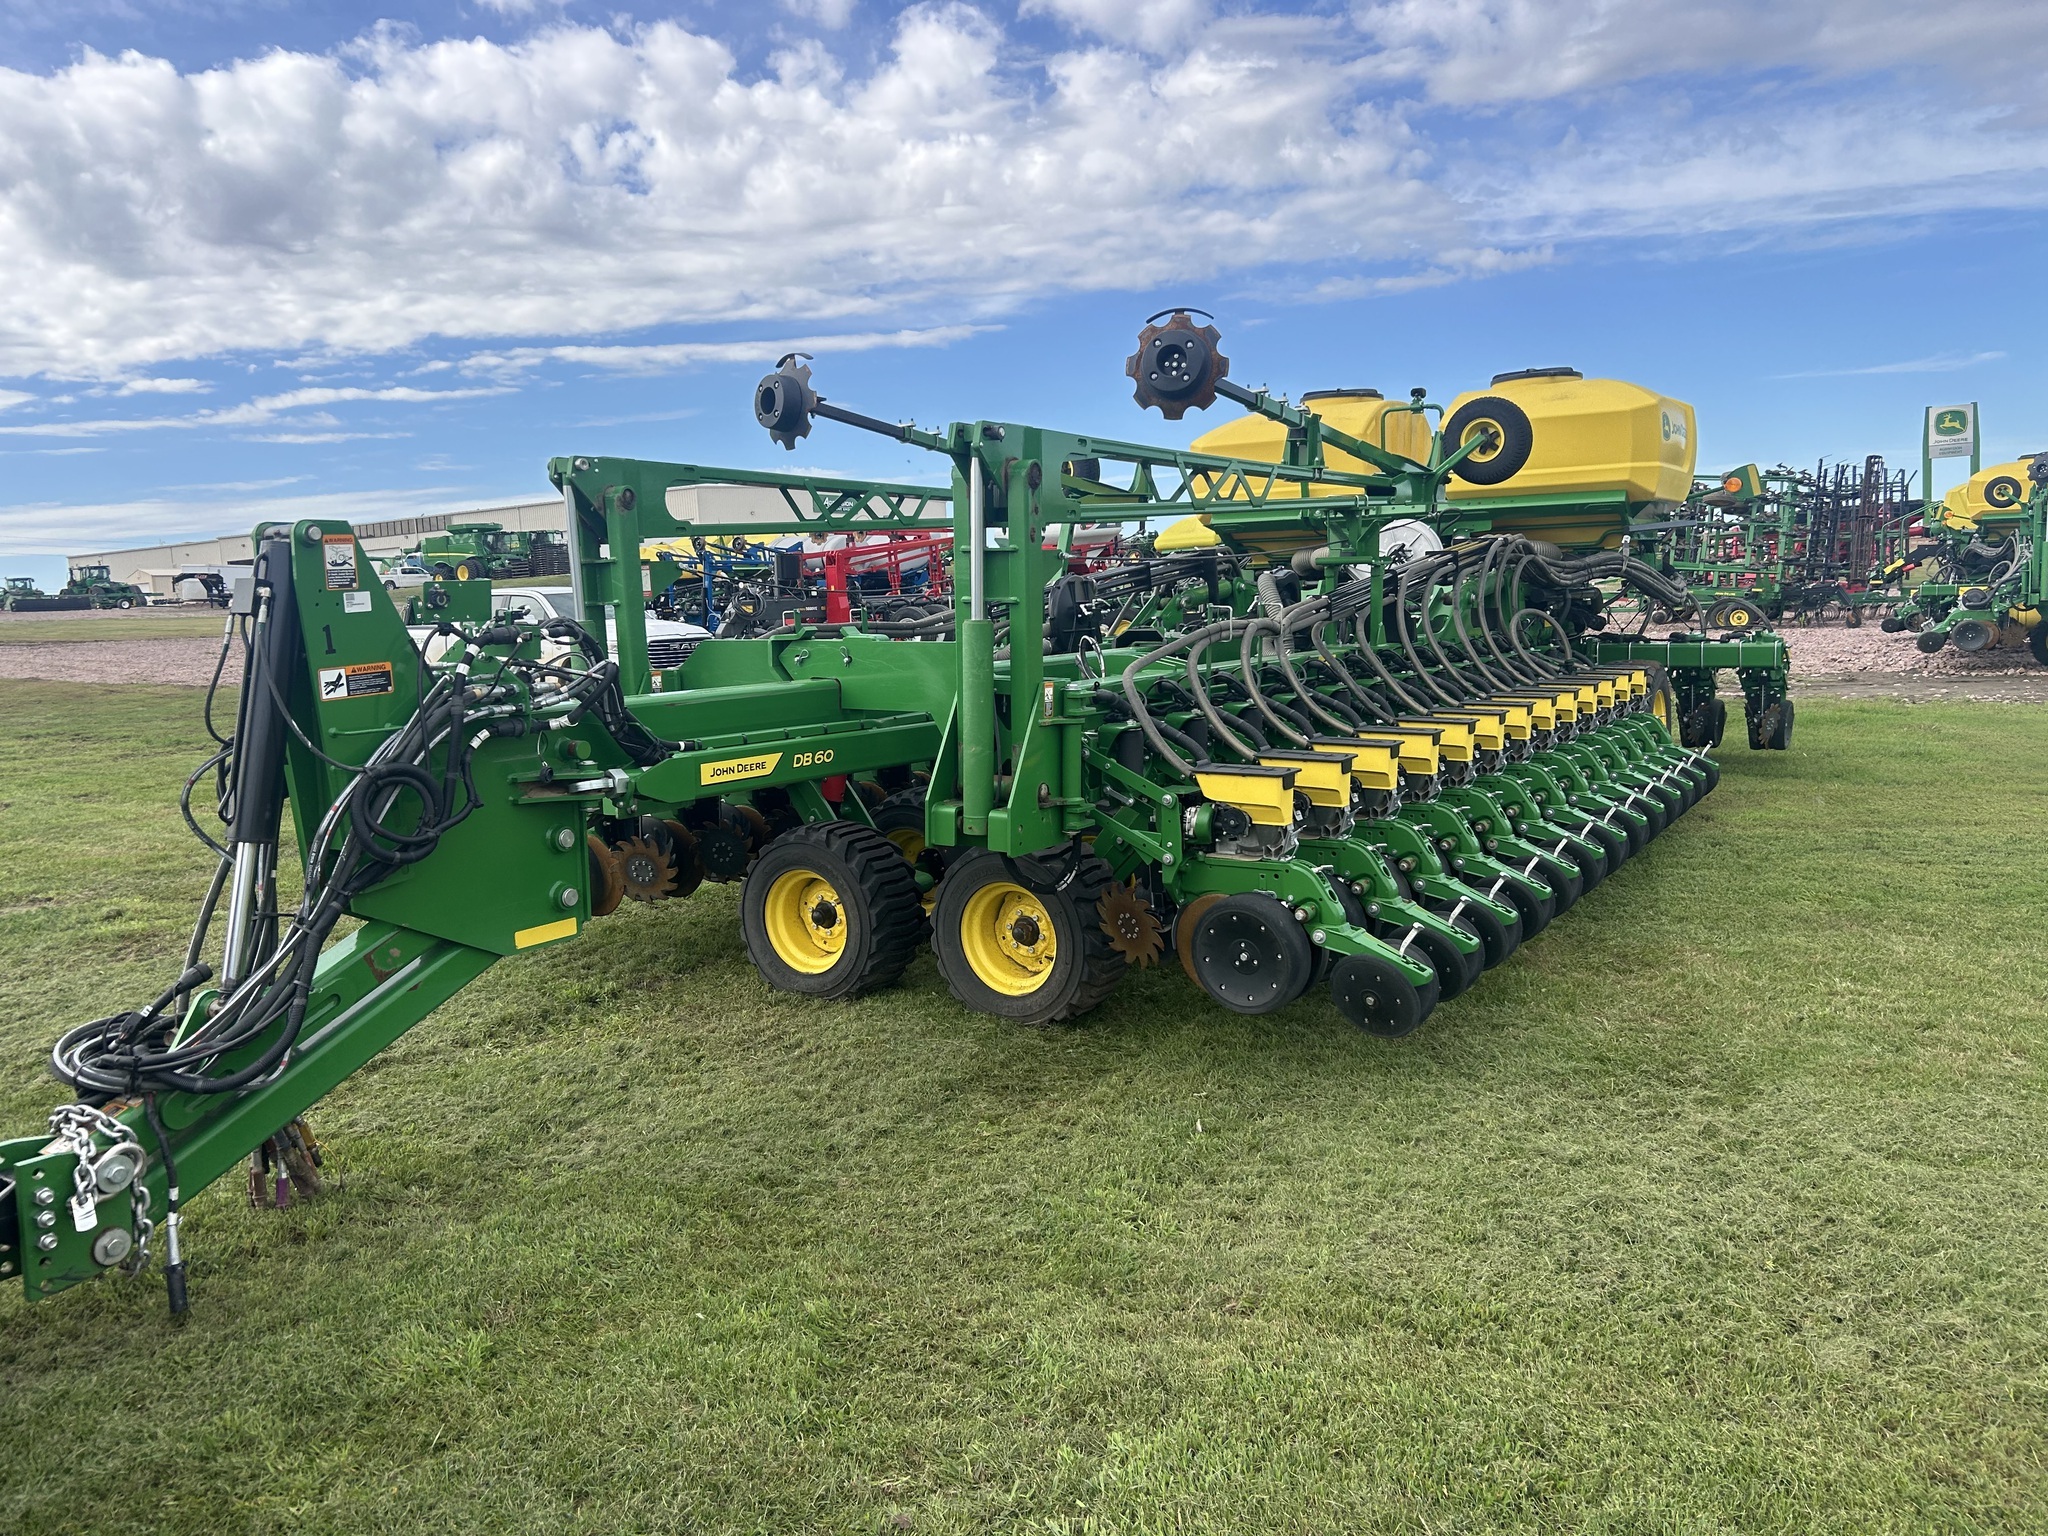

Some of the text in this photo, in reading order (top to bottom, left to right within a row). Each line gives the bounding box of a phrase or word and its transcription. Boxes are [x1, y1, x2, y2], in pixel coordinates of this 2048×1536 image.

[322, 624, 336, 655] 1
[356, 664, 386, 673] WARNING
[793, 749, 834, 768] DB 60
[710, 761, 767, 778] JOHN DEERE
